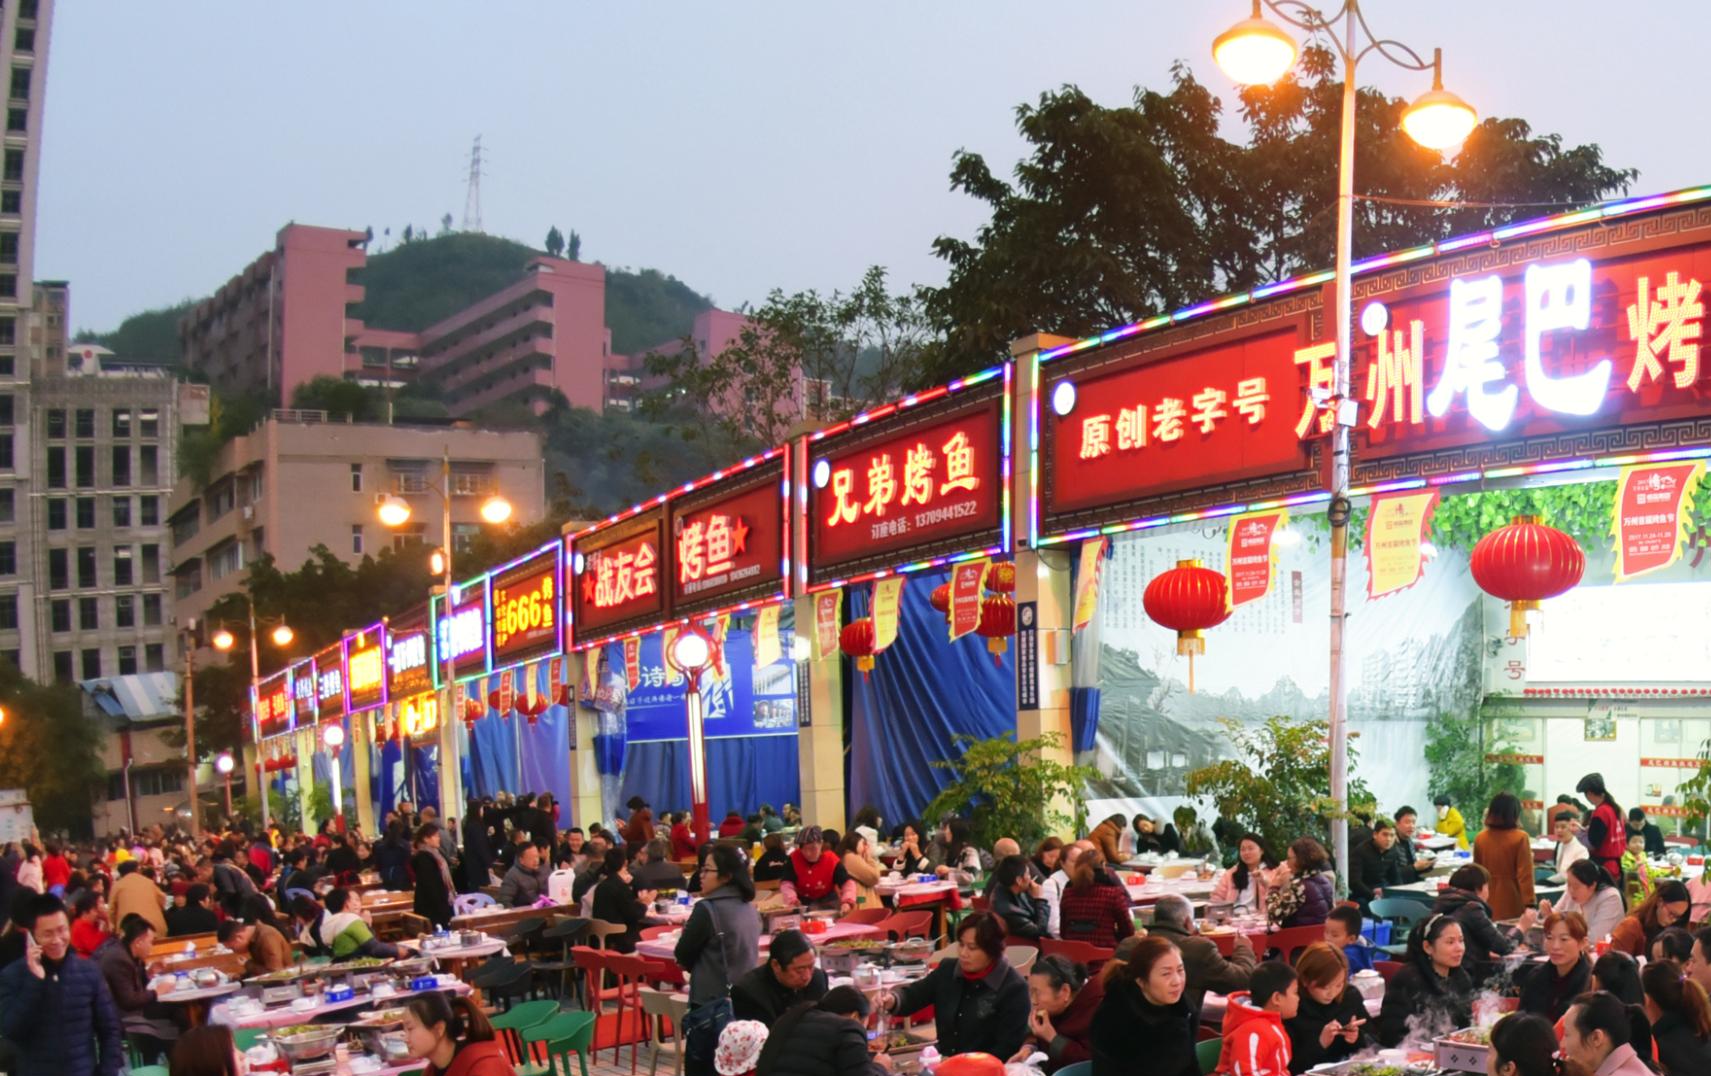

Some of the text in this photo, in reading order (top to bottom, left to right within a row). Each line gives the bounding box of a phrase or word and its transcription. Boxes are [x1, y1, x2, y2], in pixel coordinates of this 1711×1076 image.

[1079, 376, 1270, 460] 原创老字号
[827, 431, 980, 527] 兄弟烤鱼
[594, 541, 657, 608] 战友会
[678, 514, 734, 584] 烤鱼
[507, 590, 542, 635] 666
